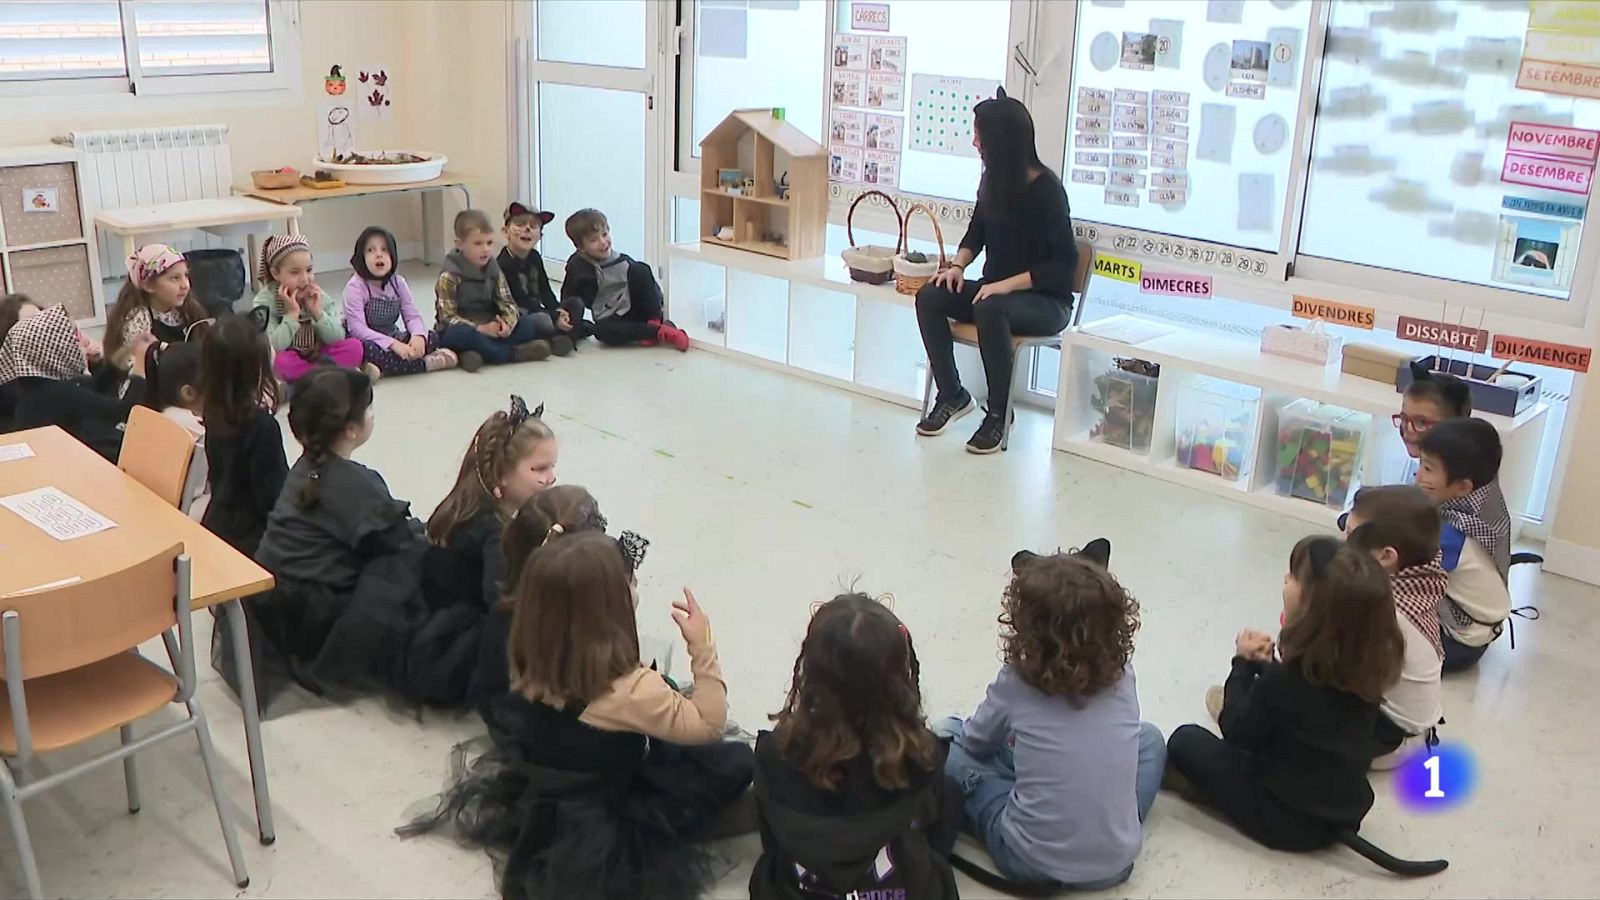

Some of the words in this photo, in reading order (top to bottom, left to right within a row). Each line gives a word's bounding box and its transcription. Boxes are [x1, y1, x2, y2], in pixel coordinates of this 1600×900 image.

[1159, 40, 1169, 51] 20
[1526, 68, 1600, 89] SETEMBRE
[1512, 131, 1595, 150] NOVEMBRE
[1510, 162, 1585, 183] DESEMBRE
[1088, 228, 1096, 240] 19
[1116, 236, 1125, 249] 21
[1127, 236, 1137, 248] 22
[1143, 239, 1154, 252] 23
[1160, 242, 1169, 254] 24
[1174, 244, 1185, 257] 25
[1189, 247, 1200, 260] 26
[1205, 250, 1215, 262] 27
[1220, 252, 1232, 264] 28
[1238, 257, 1250, 270] 29
[1254, 261, 1265, 274] 30
[1142, 278, 1210, 294] DIMECRES
[1293, 299, 1374, 327] DIVENDRES
[1404, 322, 1479, 348] DISSABTE
[1494, 340, 1589, 367] DIUMENGE
